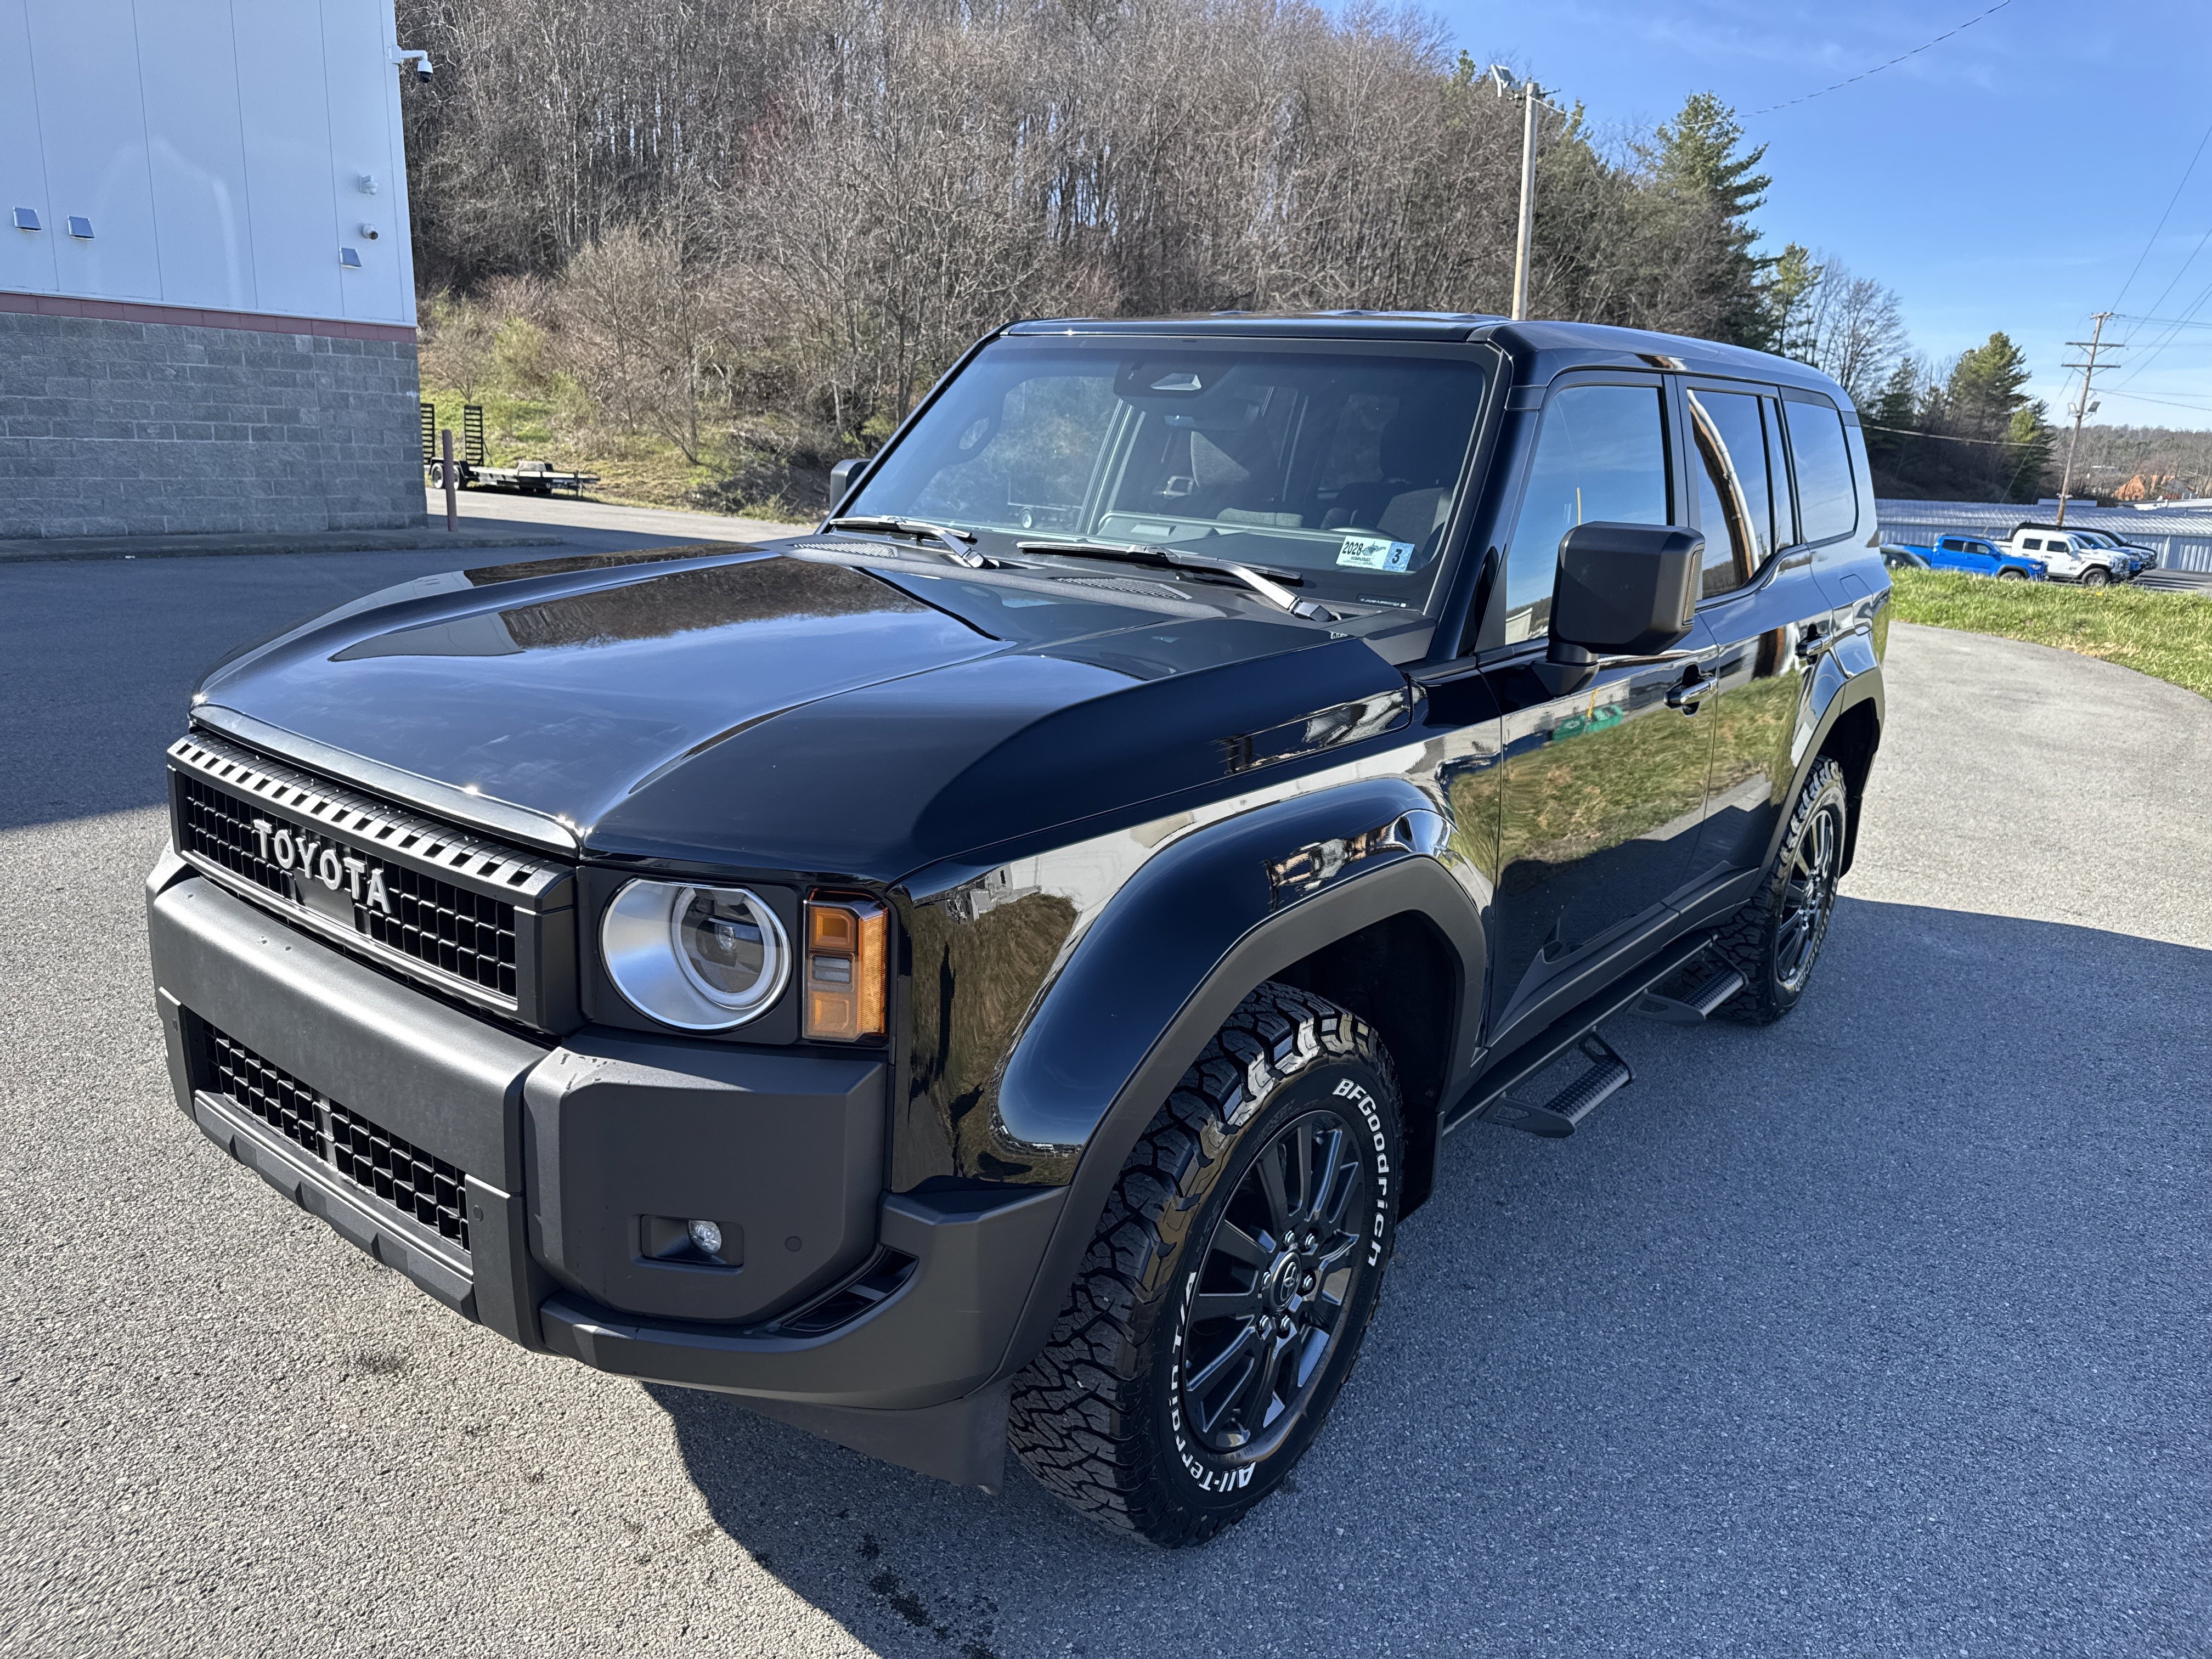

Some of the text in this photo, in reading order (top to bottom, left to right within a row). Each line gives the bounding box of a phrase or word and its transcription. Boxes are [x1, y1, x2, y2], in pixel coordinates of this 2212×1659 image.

[1342, 541, 1364, 556] 2028
[1392, 549, 1403, 564] 3
[253, 819, 392, 914] TOYOTA
[1332, 1078, 1389, 1267] BFGoodrich
[1172, 1271, 1197, 1354] T/A
[1169, 1364, 1256, 1492] All-Terrain
